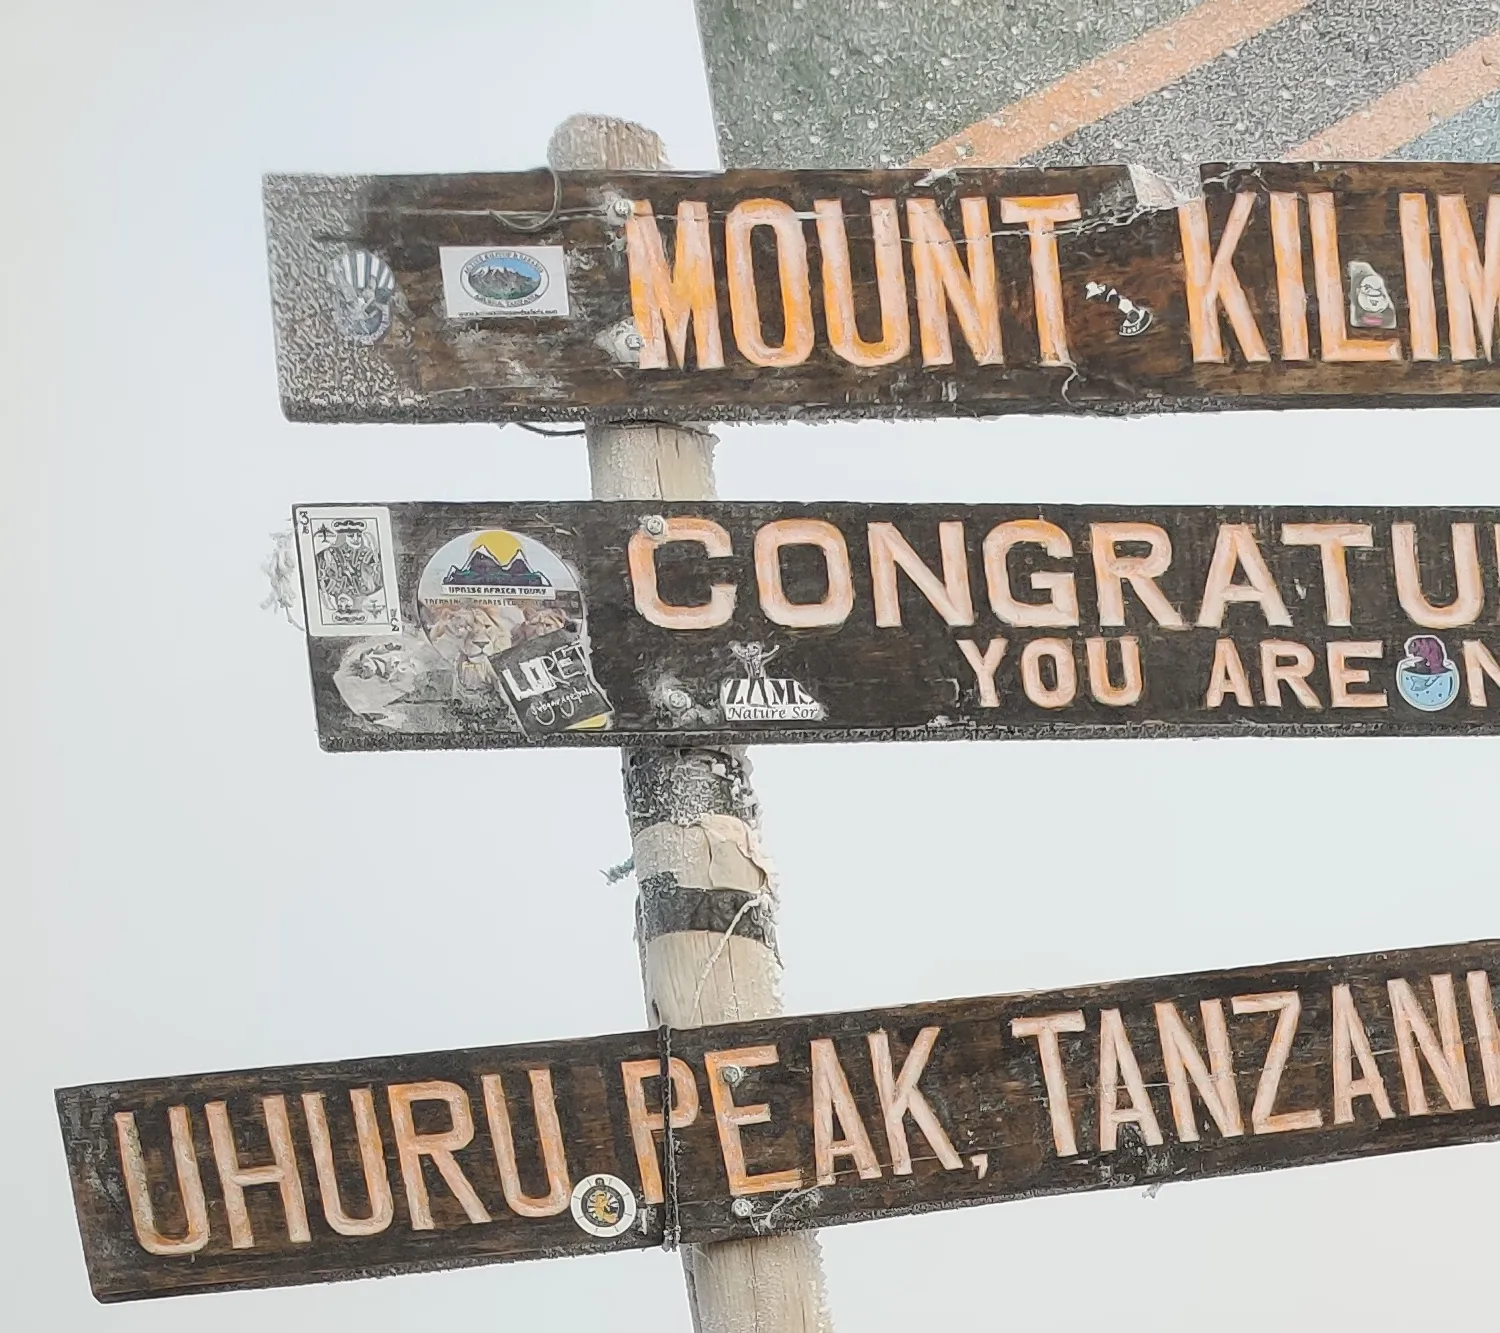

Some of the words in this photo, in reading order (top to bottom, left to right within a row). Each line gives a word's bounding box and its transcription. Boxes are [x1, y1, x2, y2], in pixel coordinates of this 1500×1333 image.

[624, 193, 1081, 370] MOUNT
[728, 706, 786, 720] Nature
[956, 636, 1144, 710] YOU
[1206, 637, 1390, 710] ARE
[114, 1067, 572, 1257] UHURU
[620, 1026, 989, 1205] PEAK,
